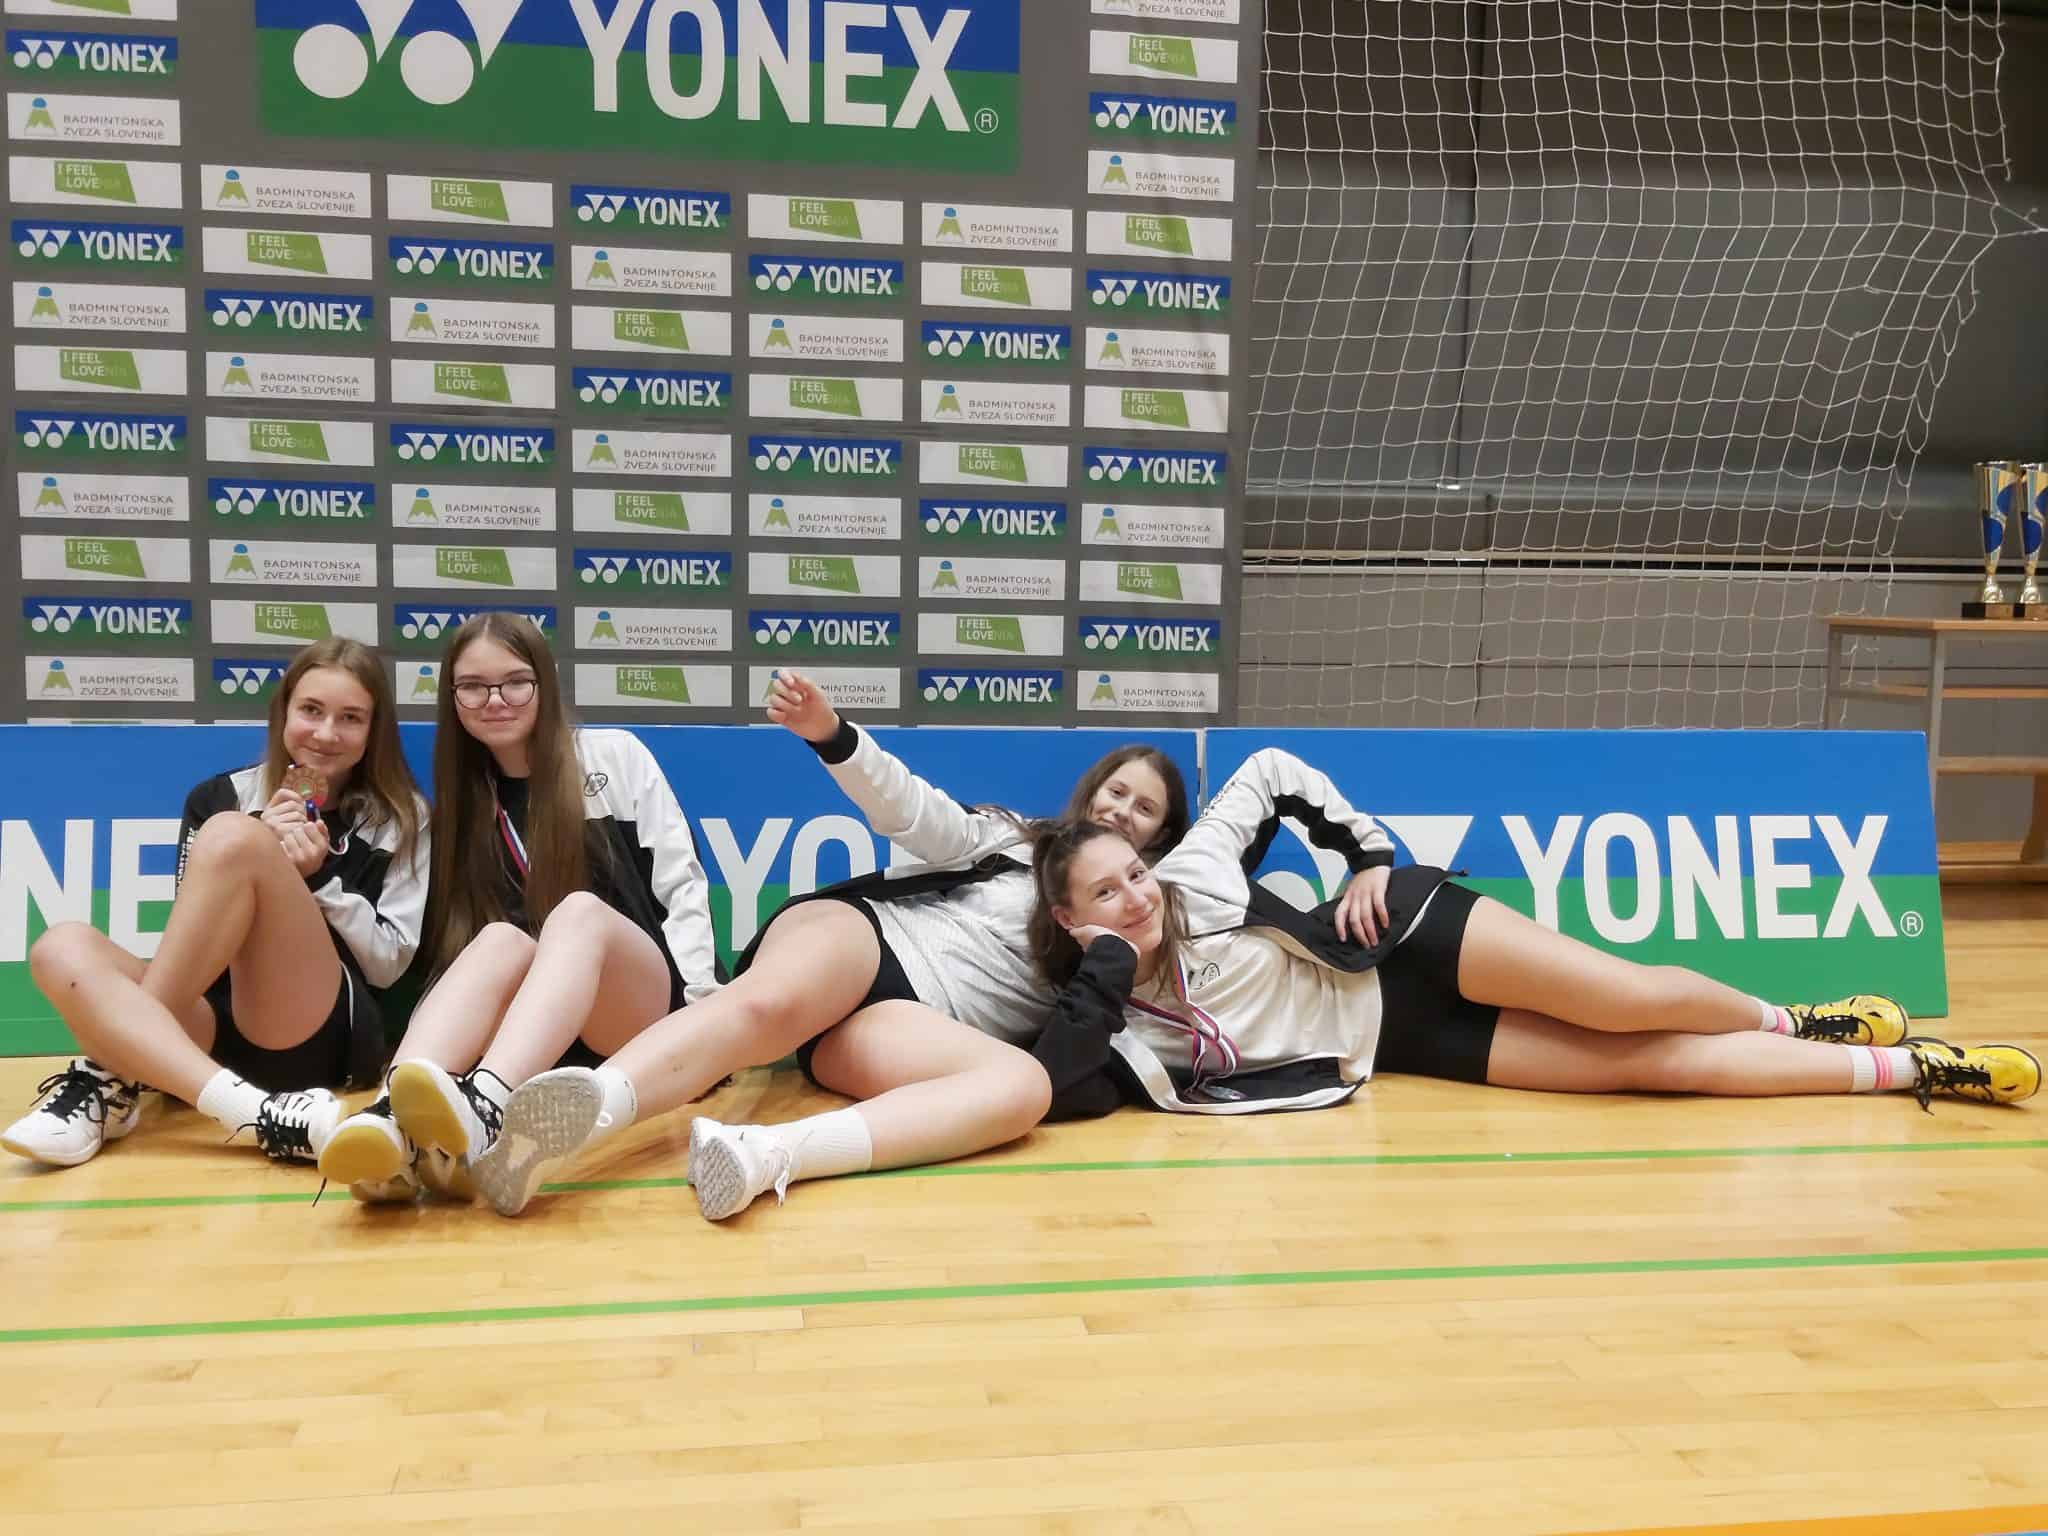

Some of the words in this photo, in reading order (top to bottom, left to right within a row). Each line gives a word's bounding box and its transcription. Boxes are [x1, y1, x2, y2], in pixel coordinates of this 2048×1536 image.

[73, 42, 166, 73] YONEX
[63, 115, 164, 127] BADMINTONSKA
[1148, 104, 1225, 135] YONEX
[63, 127, 100, 137] ZVEZA
[104, 128, 164, 140] SLOVENIJE
[66, 164, 96, 175] FEEL
[256, 187, 355, 200] BADMINTONSKA
[442, 183, 471, 194] FEEL
[256, 199, 293, 209] ZVEZA
[296, 201, 355, 213] SLOVENIJE
[800, 202, 827, 213] FEEL
[634, 197, 719, 227] YONEX
[970, 223, 1058, 235] BADMINTONSKA
[259, 235, 288, 246] FEEL
[970, 235, 1002, 244] ZVEZA
[1006, 236, 1058, 247] SLOVENIJE
[79, 232, 171, 261] YONEX
[454, 249, 542, 278] YONEX
[623, 267, 716, 279] BADMINTONSKA
[971, 270, 997, 280] FEEL
[623, 278, 657, 288] ZVEZA
[660, 280, 716, 291] SLOVENIJE
[809, 266, 892, 294] YONEX
[1144, 281, 1220, 310] YONEX
[69, 303, 170, 314] BADMINTONSKA
[69, 315, 107, 324] ZVEZA
[110, 316, 171, 327] SLOVENIJE
[271, 301, 362, 331] YONEX
[625, 314, 653, 324] FEEL
[444, 318, 540, 330] BADMINTONSKA
[444, 330, 479, 339] ZVEZA
[483, 332, 540, 343] SLOVENIJE
[799, 334, 889, 345] BADMINTONSKA
[798, 345, 831, 354] ZVEZA
[835, 347, 889, 357] SLOVENIJE
[980, 332, 1060, 360] YONEX
[72, 353, 102, 363] FEEL
[445, 367, 474, 377] FEEL
[261, 372, 359, 384] BADMINTONSKA
[261, 384, 297, 393] ZVEZA
[301, 386, 360, 397] SLOVENIJE
[800, 381, 827, 391] FEEL
[636, 378, 720, 406] YONEX
[969, 400, 1056, 410] BADMINTONSKA
[969, 411, 1001, 419] ZVEZA
[1004, 412, 1056, 422] SLOVENIJE
[261, 425, 290, 435] FEEL
[83, 422, 175, 450] YONEX
[455, 435, 543, 462] YONEX
[969, 448, 995, 458] FEEL
[623, 450, 716, 460] BADMINTONSKA
[809, 447, 890, 474] YONEX
[624, 461, 658, 469] ZVEZA
[661, 462, 716, 472] SLOVENIJE
[1139, 458, 1216, 484] YONEX
[74, 493, 173, 503] BADMINTONSKA
[274, 490, 363, 517] YONEX
[626, 496, 653, 506] FEEL
[74, 505, 111, 513] ZVEZA
[114, 506, 174, 516] SLOVENIJE
[446, 504, 541, 514] BADMINTONSKA
[445, 515, 481, 523] ZVEZA
[484, 516, 541, 526] SLOVENIJE
[798, 513, 887, 523] BADMINTONSKA
[977, 509, 1056, 535] YONEX
[798, 524, 830, 533] ZVEZA
[833, 525, 887, 535] SLOVENIJE
[77, 542, 106, 552] FEEL
[447, 551, 476, 561] FEEL
[264, 559, 361, 569] BADMINTONSKA
[799, 559, 825, 569] FEEL
[264, 571, 300, 579] ZVEZA
[303, 572, 362, 582] SLOVENIJE
[636, 559, 720, 585] YONEX
[966, 575, 1051, 584] BADMINTONSKA
[966, 586, 997, 594] ZVEZA
[1001, 587, 1051, 596] SLOVENIJE
[267, 607, 296, 616] FEEL
[90, 607, 180, 633] YONEX
[966, 619, 991, 628] FEEL
[626, 626, 718, 634] BADMINTONSKA
[809, 620, 889, 645] YONEX
[663, 637, 718, 646] SLOVENIJE
[1135, 626, 1209, 651] YONEX
[81, 675, 179, 684] BADMINTONSKA
[627, 670, 654, 679] FEEL
[81, 687, 117, 695] ZVEZA
[120, 687, 179, 697] SLOVENIJE
[820, 684, 887, 693] MINTONSKA
[975, 677, 1052, 702] YONEX
[1500, 812, 1898, 944] YONEX
